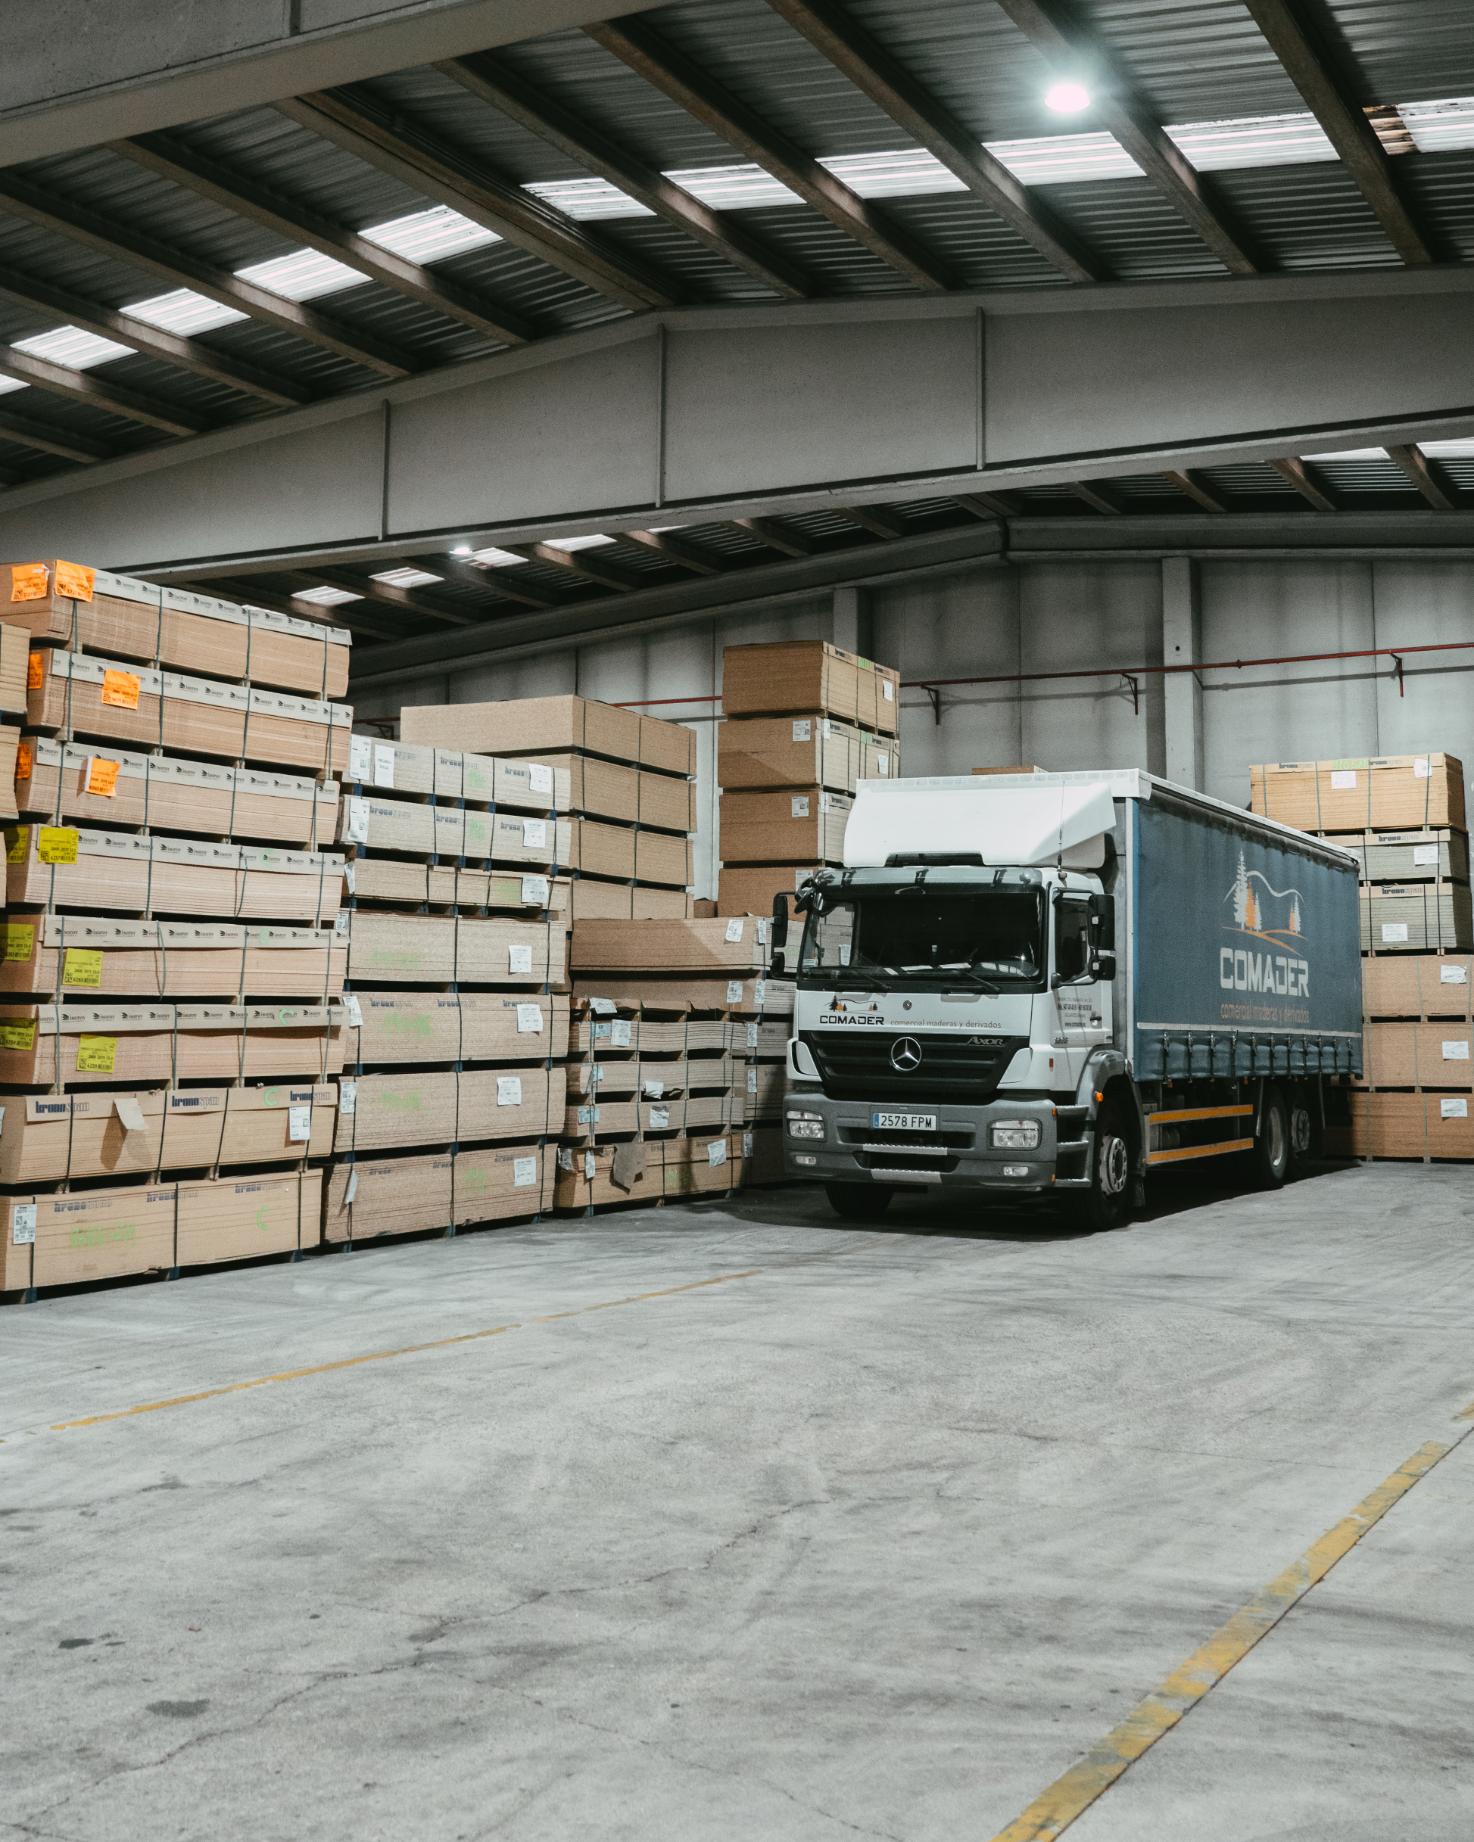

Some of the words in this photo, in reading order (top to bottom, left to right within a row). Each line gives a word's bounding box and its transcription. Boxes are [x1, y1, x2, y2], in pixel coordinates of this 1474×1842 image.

[1220, 947, 1310, 998] COMADER
[819, 1015, 885, 1026] COMADER
[890, 1018, 925, 1027] comercial
[926, 1019, 957, 1028] maderas
[965, 1020, 1001, 1029] derivados
[172, 1095, 220, 1109] kronospan
[881, 1115, 908, 1127] 2578
[911, 1116, 932, 1128] FPM
